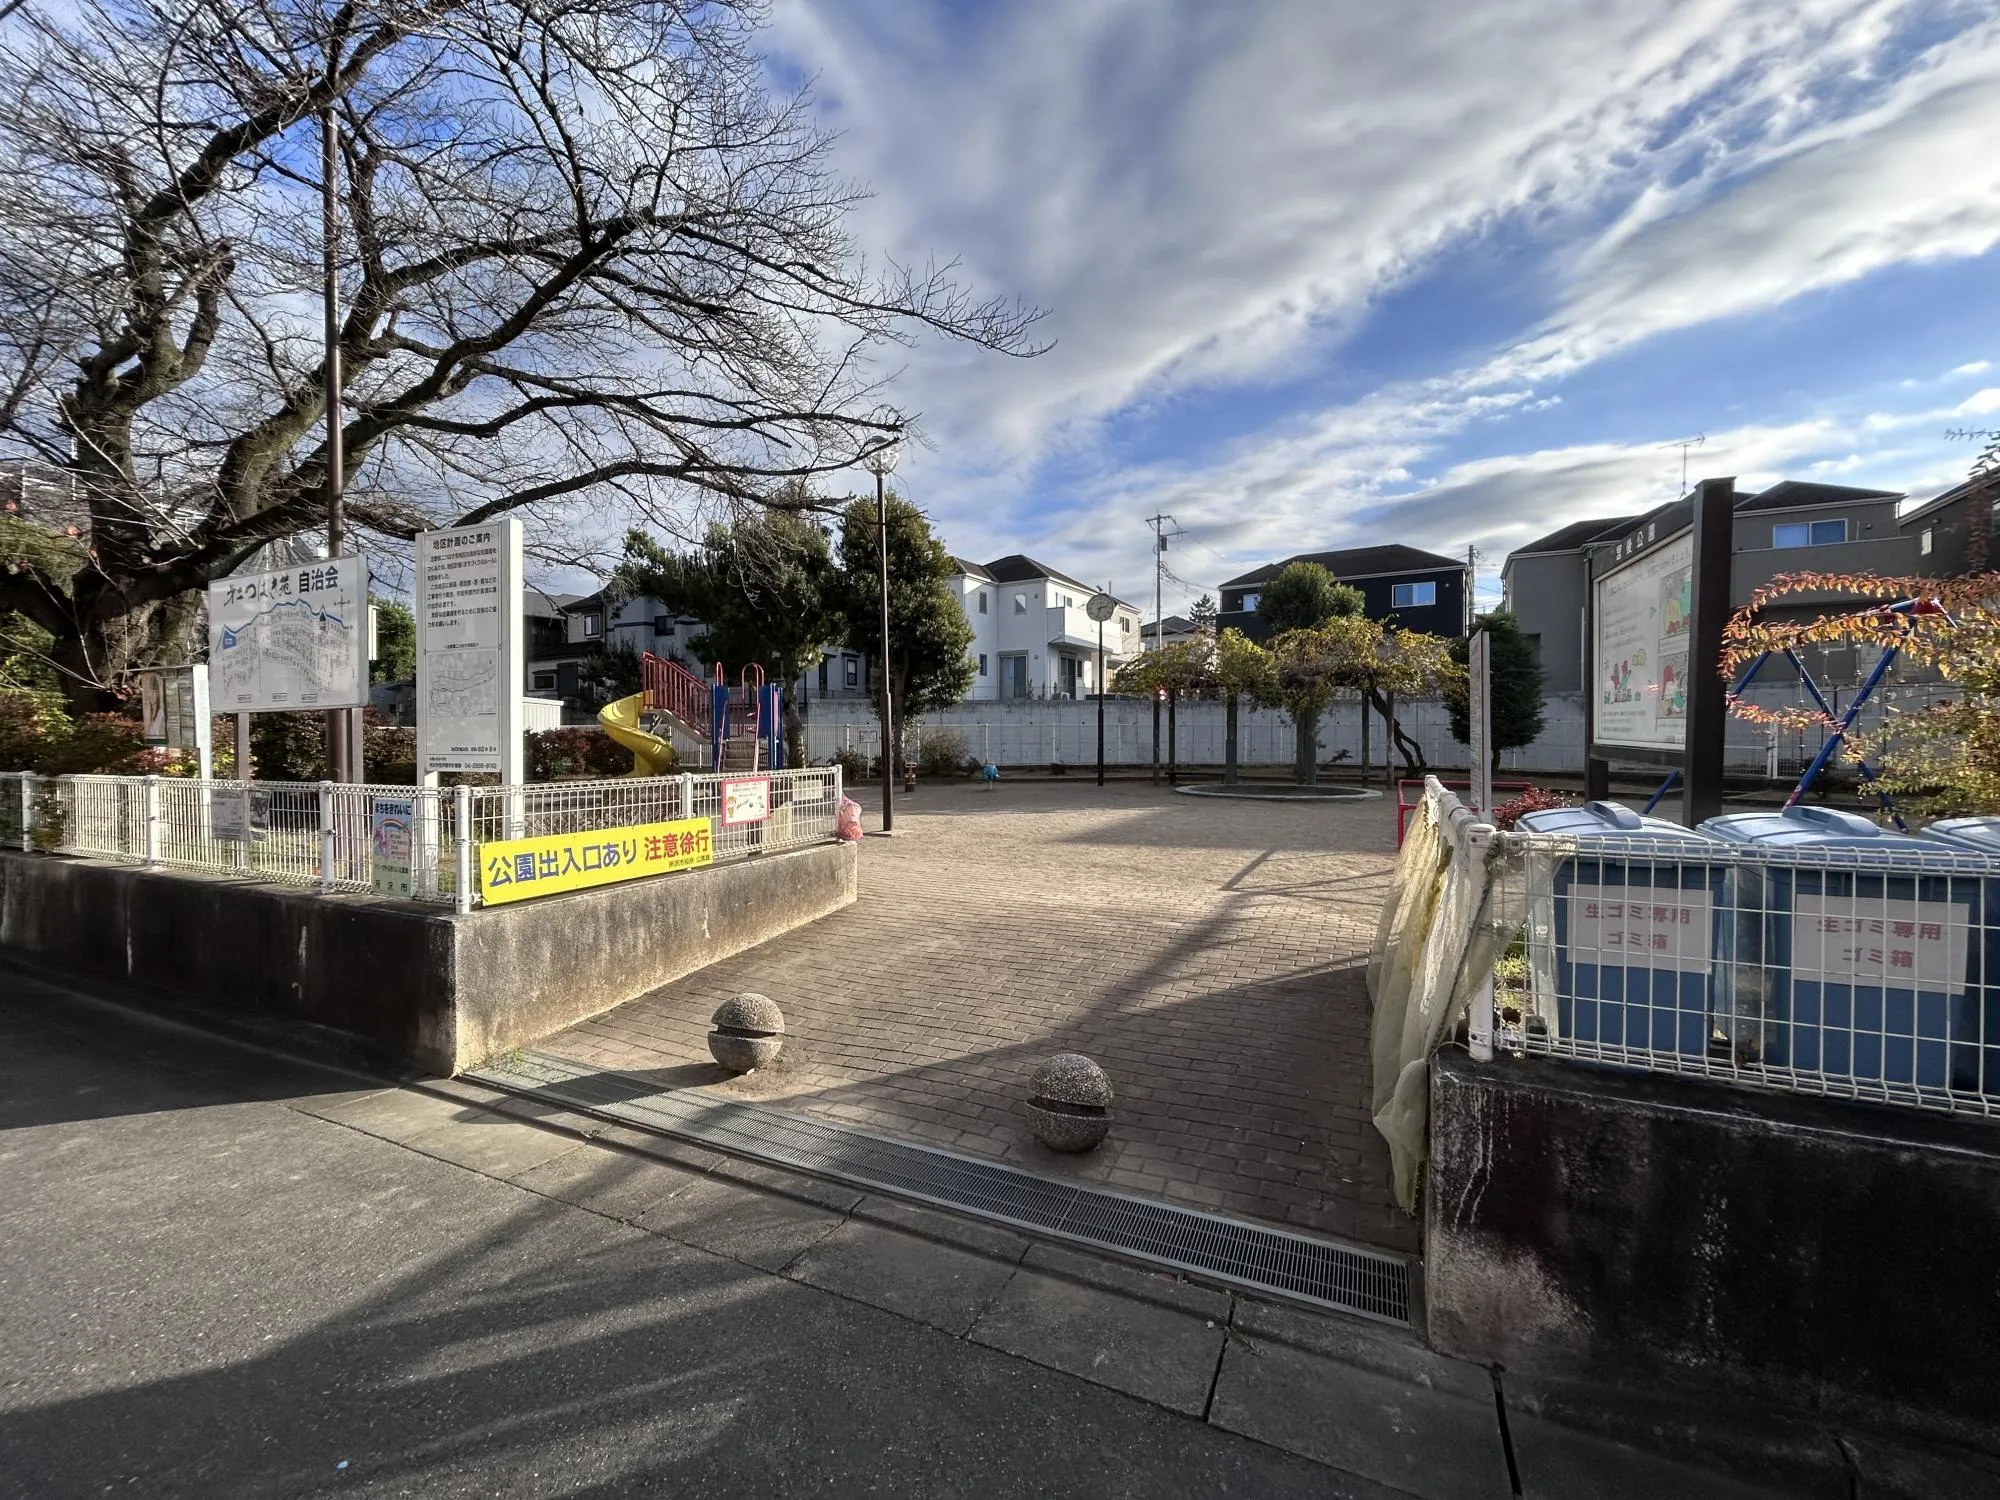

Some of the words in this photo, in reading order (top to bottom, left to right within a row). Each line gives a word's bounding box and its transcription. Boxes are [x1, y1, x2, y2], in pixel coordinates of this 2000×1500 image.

[432, 532, 491, 550] 地区計画のご案内
[299, 565, 339, 594] 自治会
[375, 803, 412, 816] まちをきれいに
[487, 838, 638, 888] 公園出入口あり
[643, 828, 710, 862] 注意徐行
[1585, 903, 1691, 925] 生ゴミ専用
[1817, 916, 1942, 941] 生ゴミ専用
[1607, 931, 1668, 950] ゴミ箱
[1842, 947, 1915, 969] ゴミ箱
